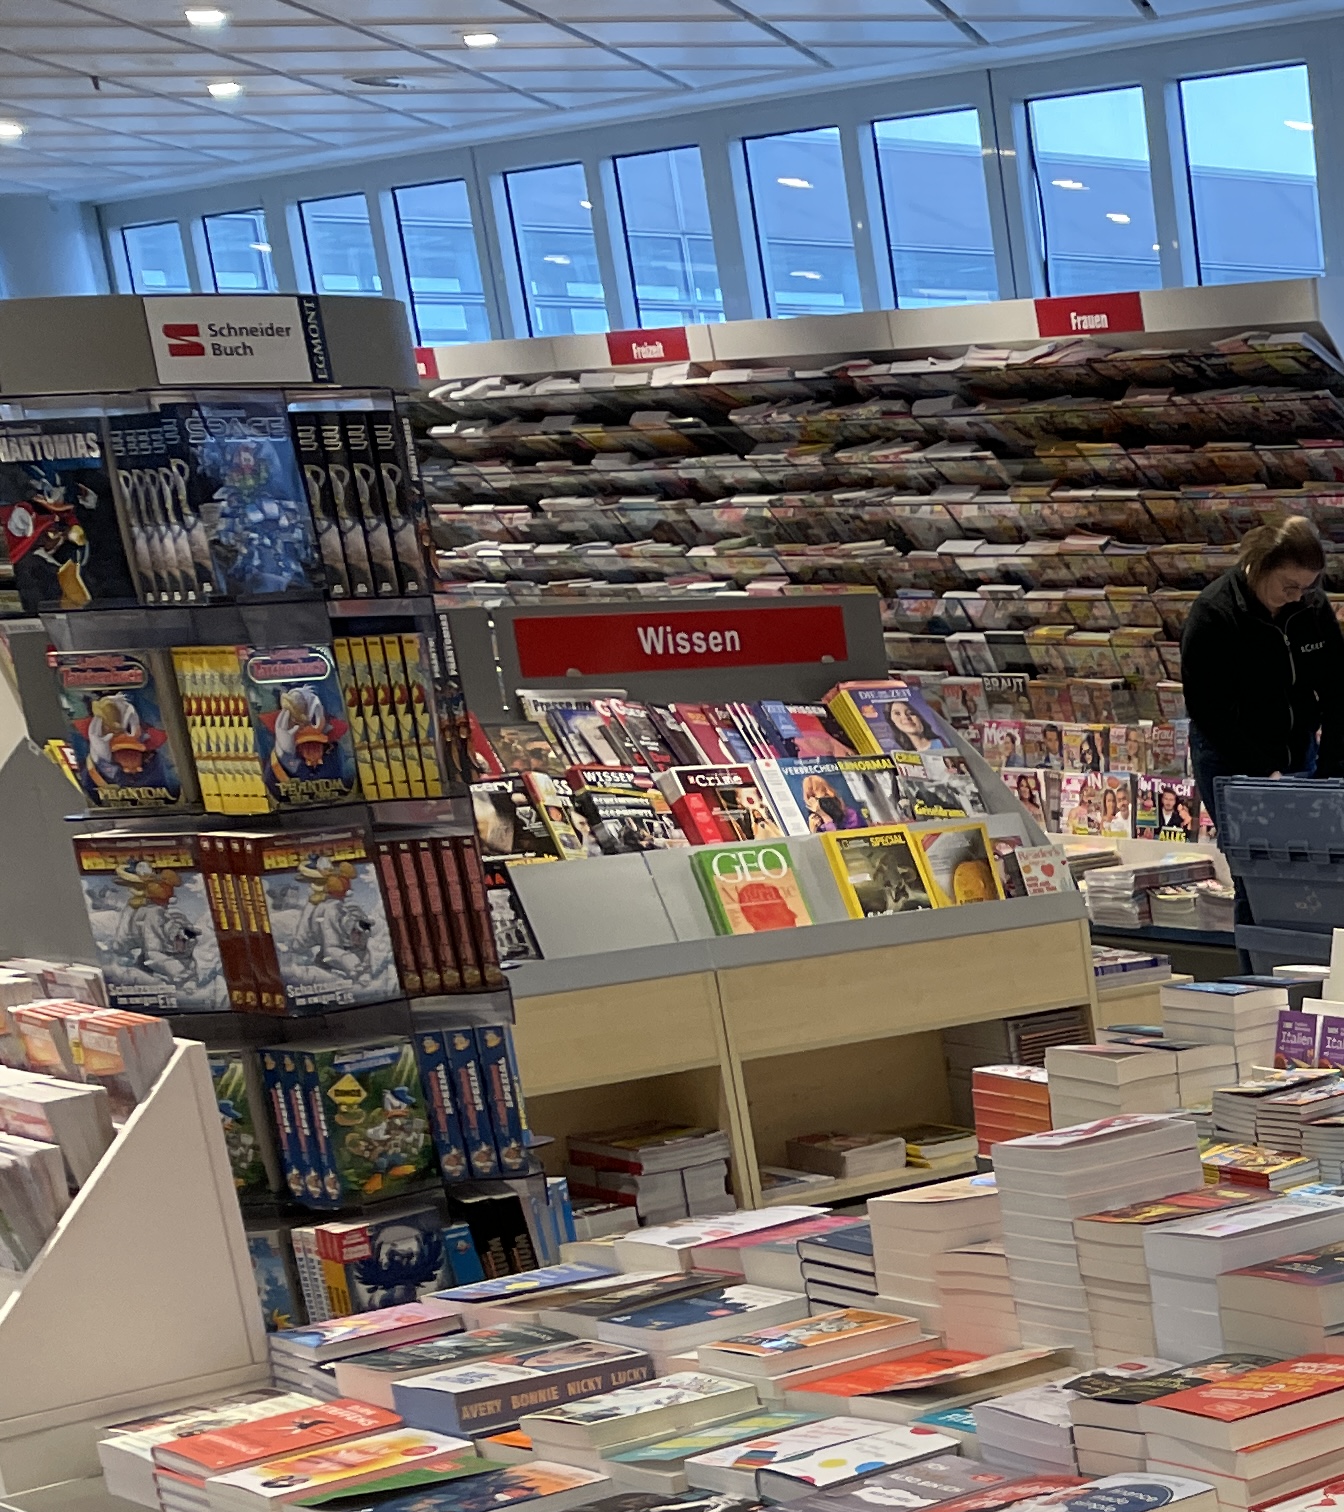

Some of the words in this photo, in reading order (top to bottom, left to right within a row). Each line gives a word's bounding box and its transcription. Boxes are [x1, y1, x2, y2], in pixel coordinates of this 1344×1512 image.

[208, 323, 292, 339] Schneider
[1071, 311, 1108, 331] Frauen
[212, 341, 254, 358] Buch
[304, 301, 328, 382] EGMONT
[631, 341, 664, 359] Freizeit
[638, 625, 741, 656] Wissen
[712, 847, 788, 883] GEO
[1281, 1031, 1313, 1046] Italien
[460, 1398, 504, 1421] AVERY
[510, 1386, 560, 1409] BONNIE
[567, 1375, 602, 1400] NICKY
[610, 1366, 650, 1389] LUCKY
